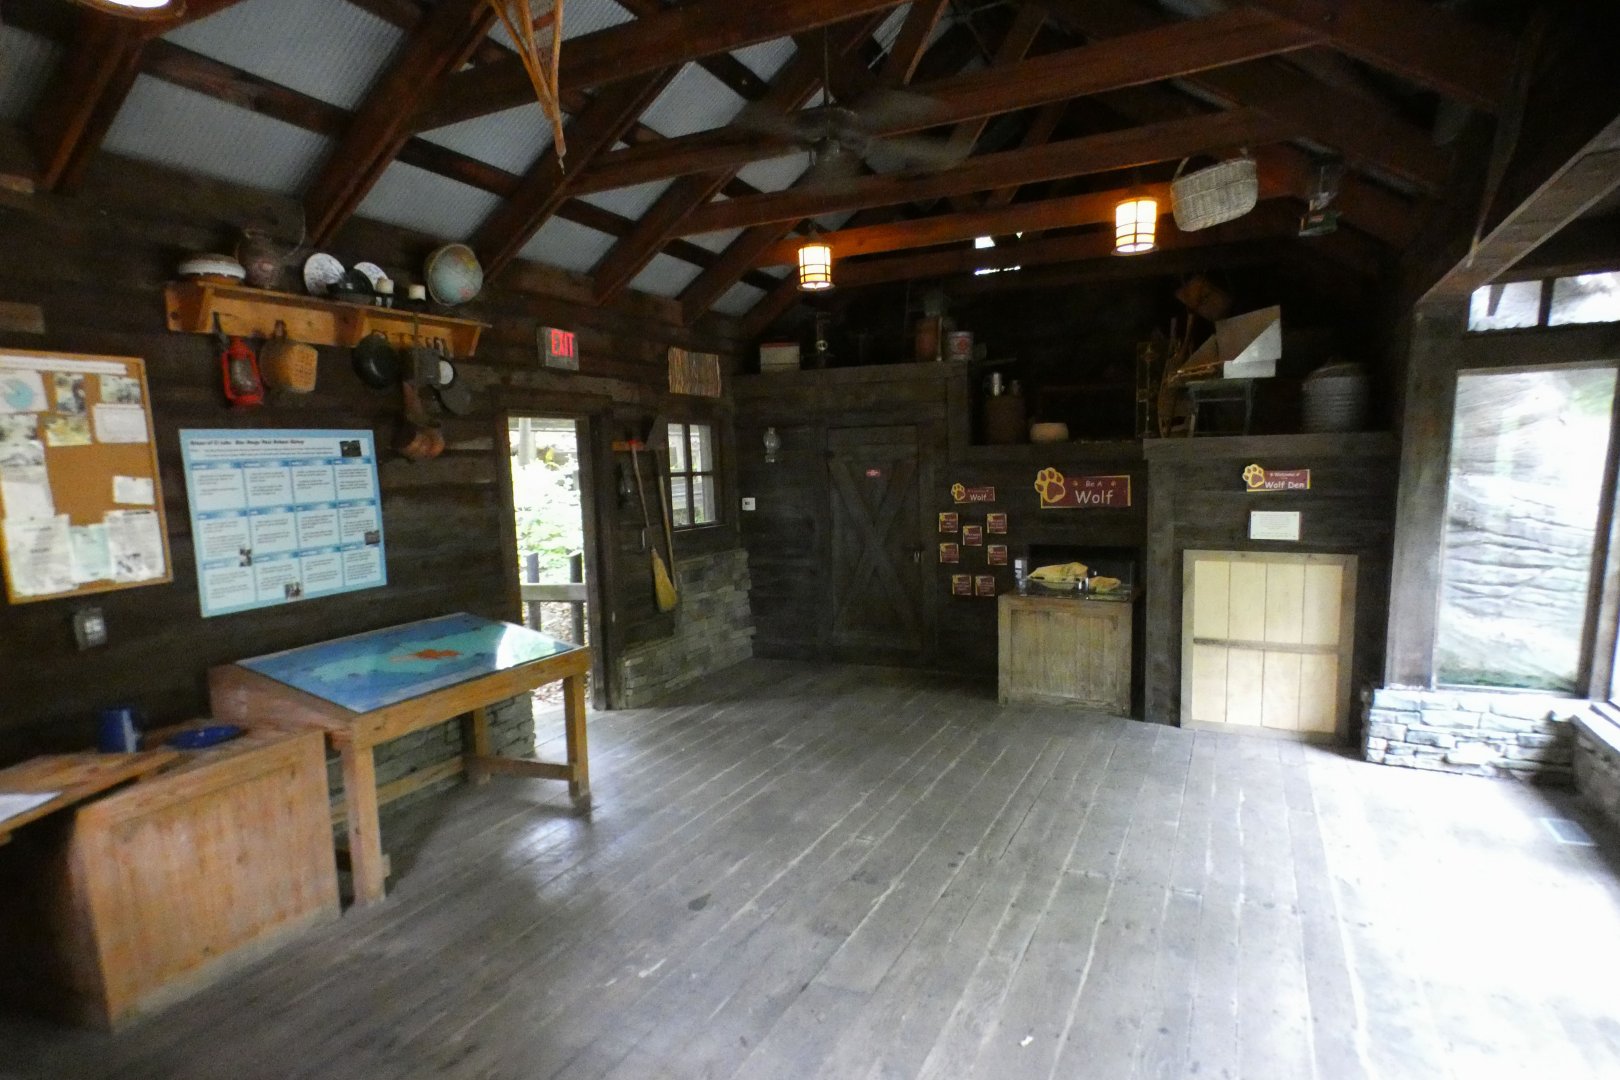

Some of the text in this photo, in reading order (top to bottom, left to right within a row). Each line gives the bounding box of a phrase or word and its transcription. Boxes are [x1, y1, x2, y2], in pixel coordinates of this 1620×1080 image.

[551, 328, 575, 359] EXIT
[1264, 481, 1305, 489] Wolf Den
[969, 494, 987, 502] Wolf
[1075, 489, 1114, 505] Wolf
